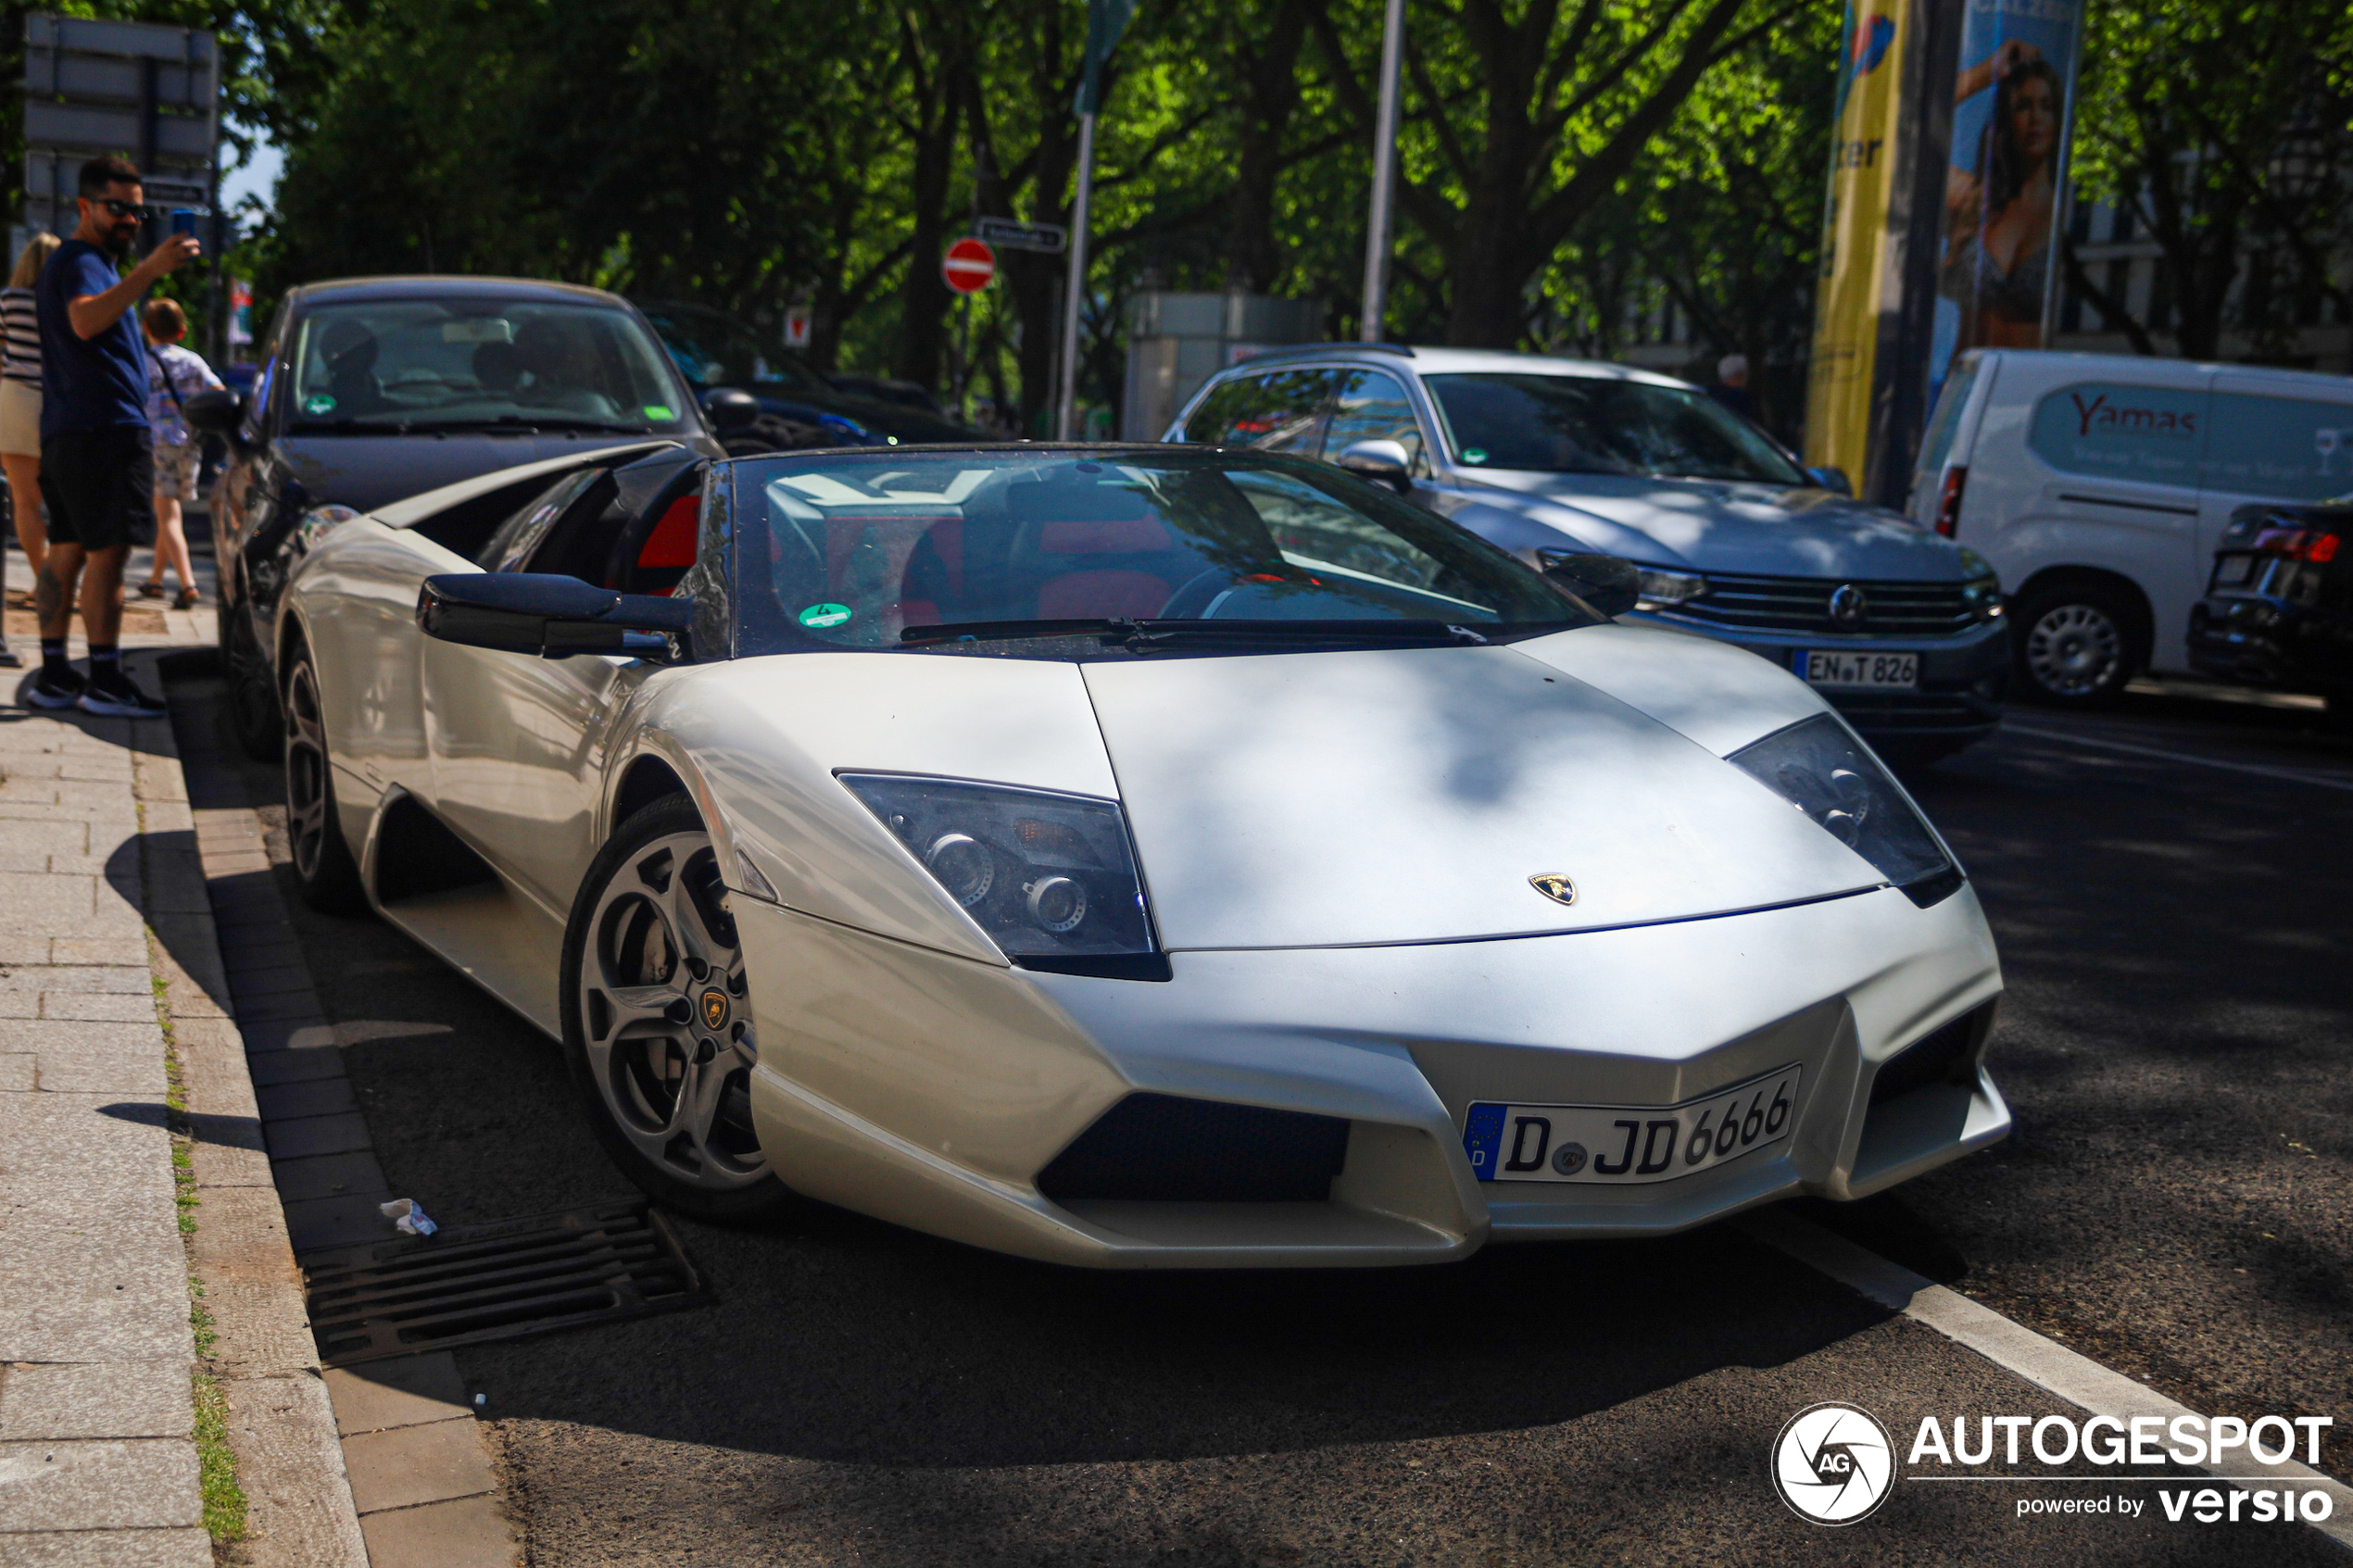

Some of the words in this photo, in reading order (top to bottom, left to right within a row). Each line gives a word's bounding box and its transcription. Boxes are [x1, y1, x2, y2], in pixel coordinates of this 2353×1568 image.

[2072, 392, 2197, 436] Yamas
[1873, 658, 1913, 683] 826
[1471, 1150, 1485, 1165] D
